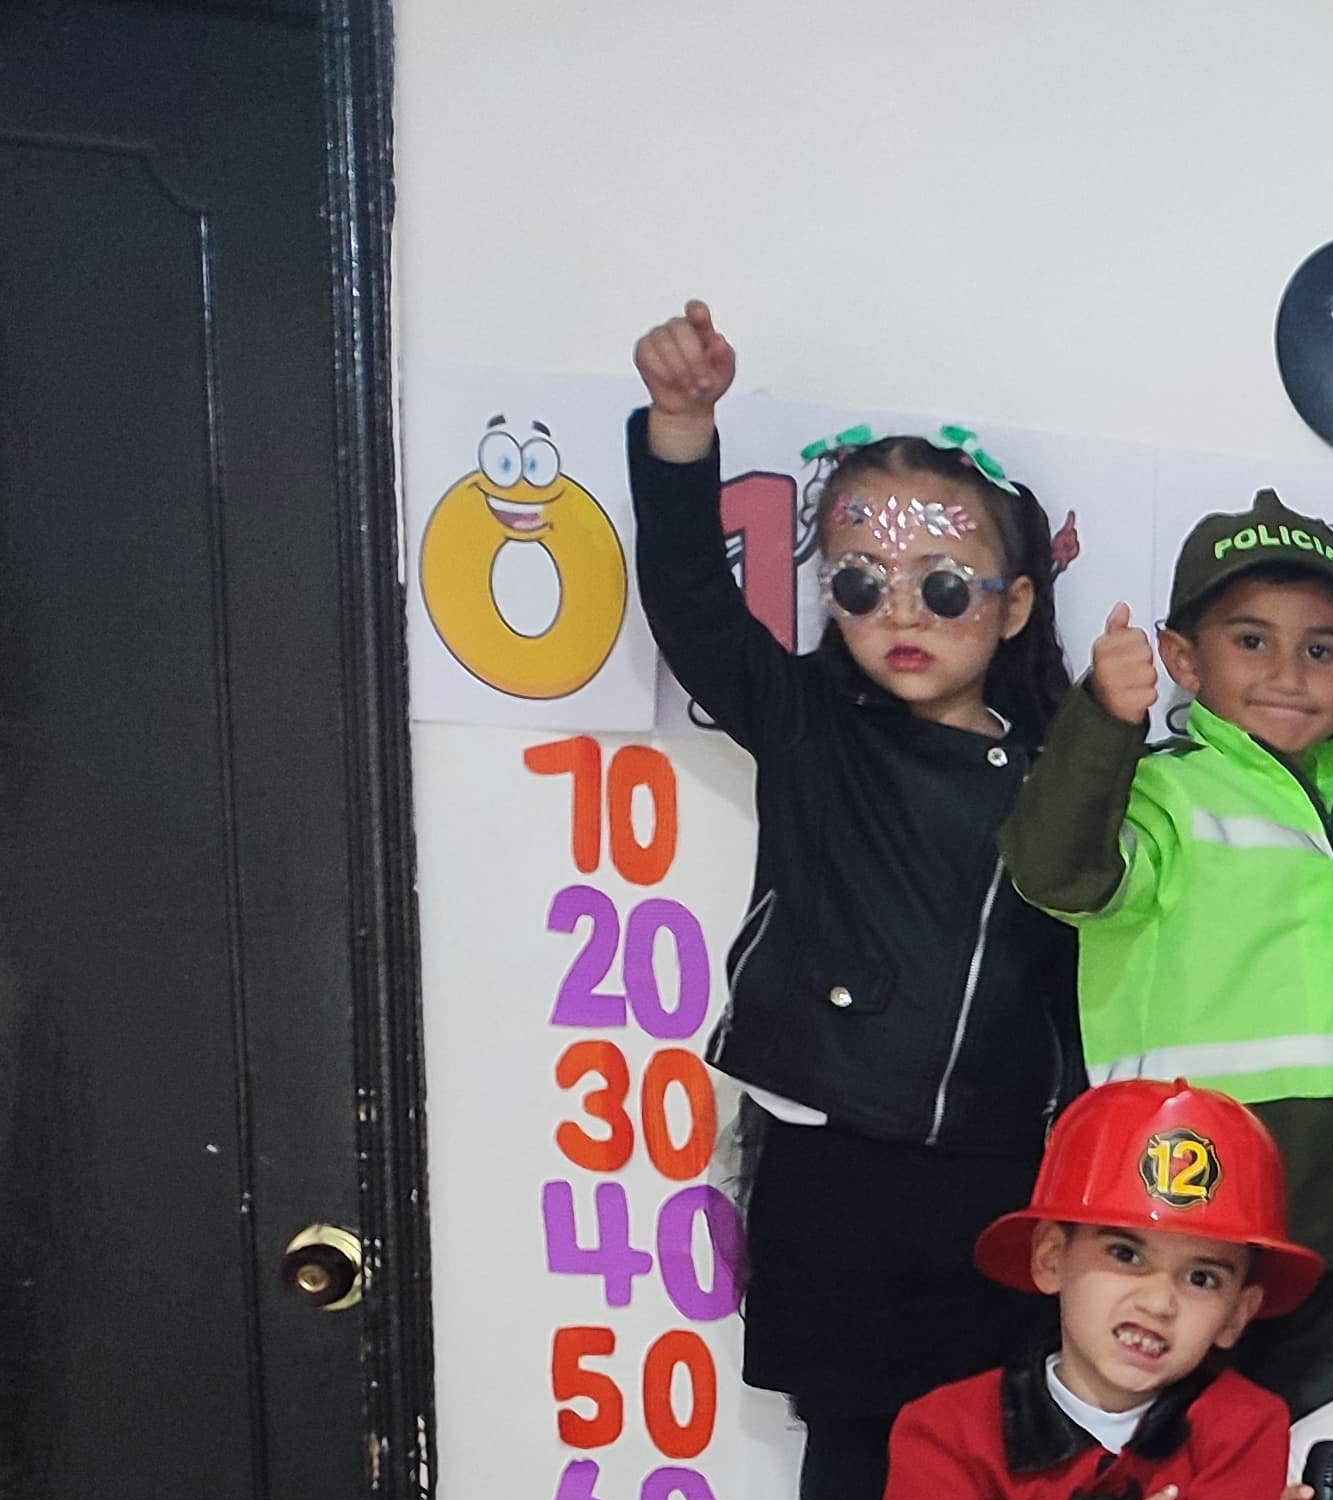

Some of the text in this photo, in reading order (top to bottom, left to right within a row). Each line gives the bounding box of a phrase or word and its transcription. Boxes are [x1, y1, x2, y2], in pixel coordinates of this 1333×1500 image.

[419, 466, 628, 700] 0
[522, 735, 678, 887] 10
[546, 884, 711, 1039] 20
[555, 1039, 717, 1181] 30
[1148, 1140, 1209, 1197] 12
[541, 1180, 748, 1321] 40
[551, 1325, 717, 1460] 50
